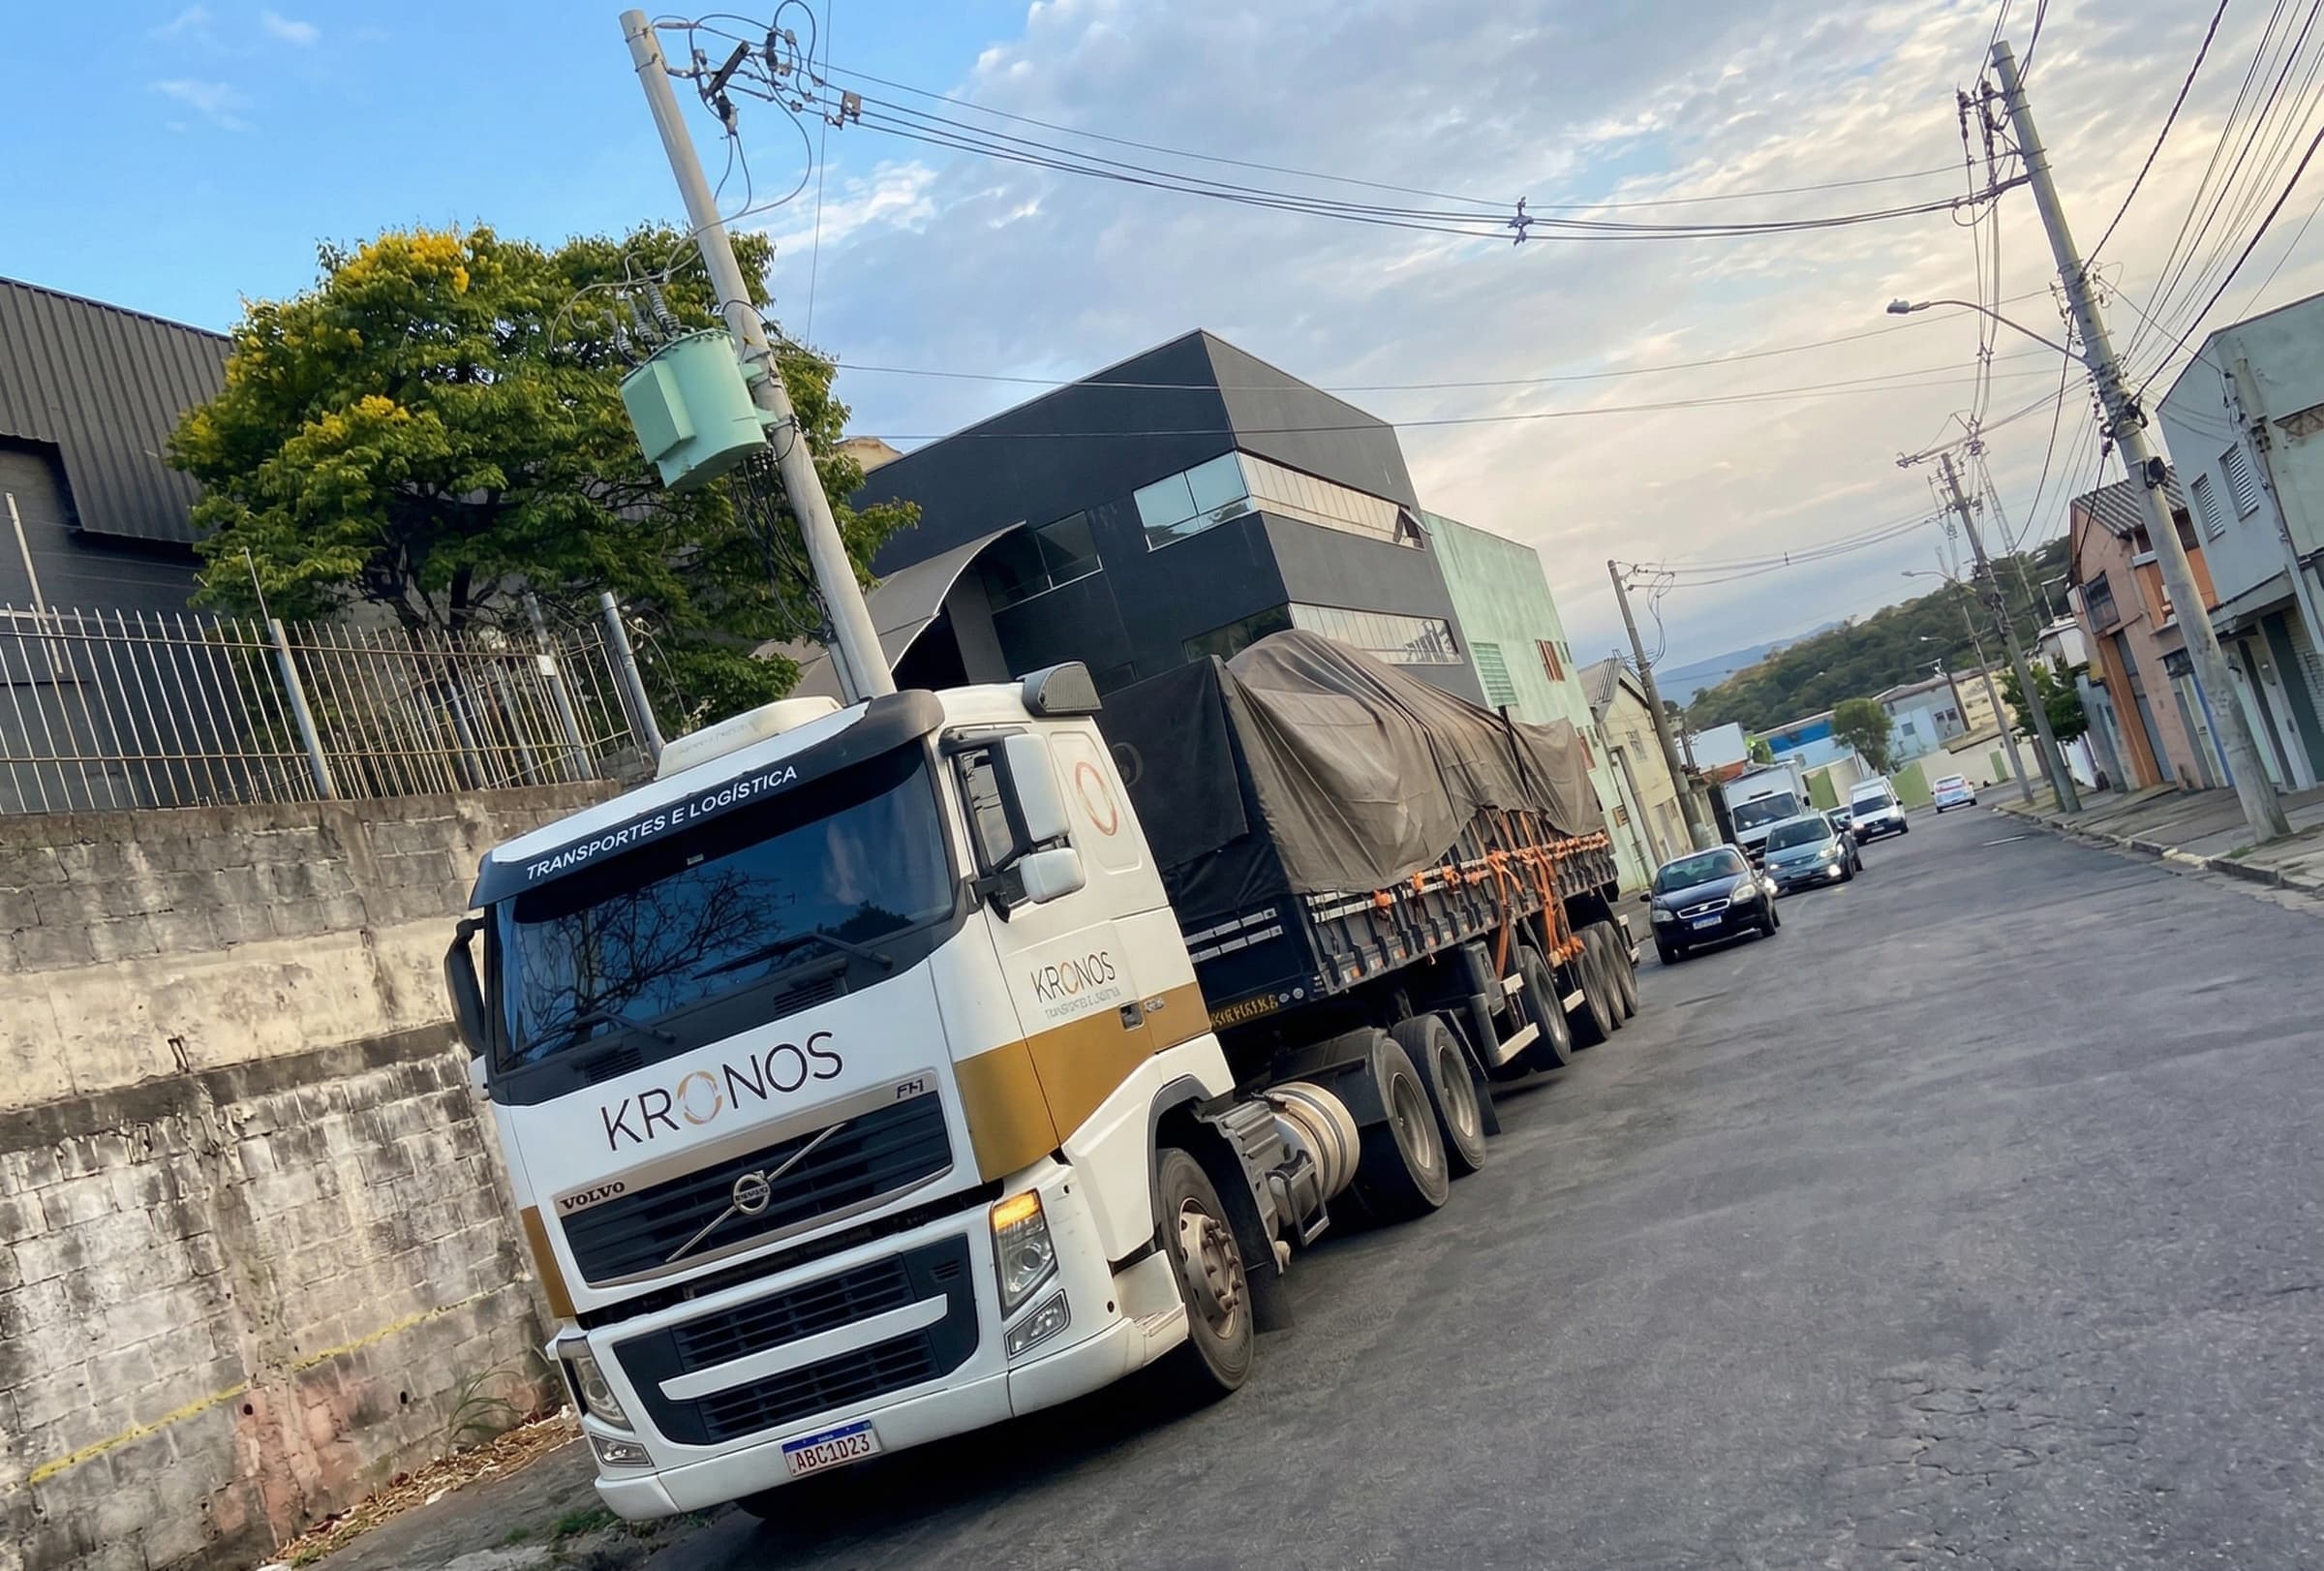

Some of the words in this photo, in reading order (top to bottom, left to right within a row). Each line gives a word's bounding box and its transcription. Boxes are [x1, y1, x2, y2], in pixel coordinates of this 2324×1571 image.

[527, 815, 665, 879] TRANSPORTES
[671, 807, 685, 824] E
[689, 765, 798, 817] LOGÍSTICA
[1030, 951, 1116, 1003] KRONOS
[600, 1032, 842, 1151] KRONOS
[560, 1182, 626, 1210] VOLVO
[795, 1433, 871, 1470] ABC1D23
